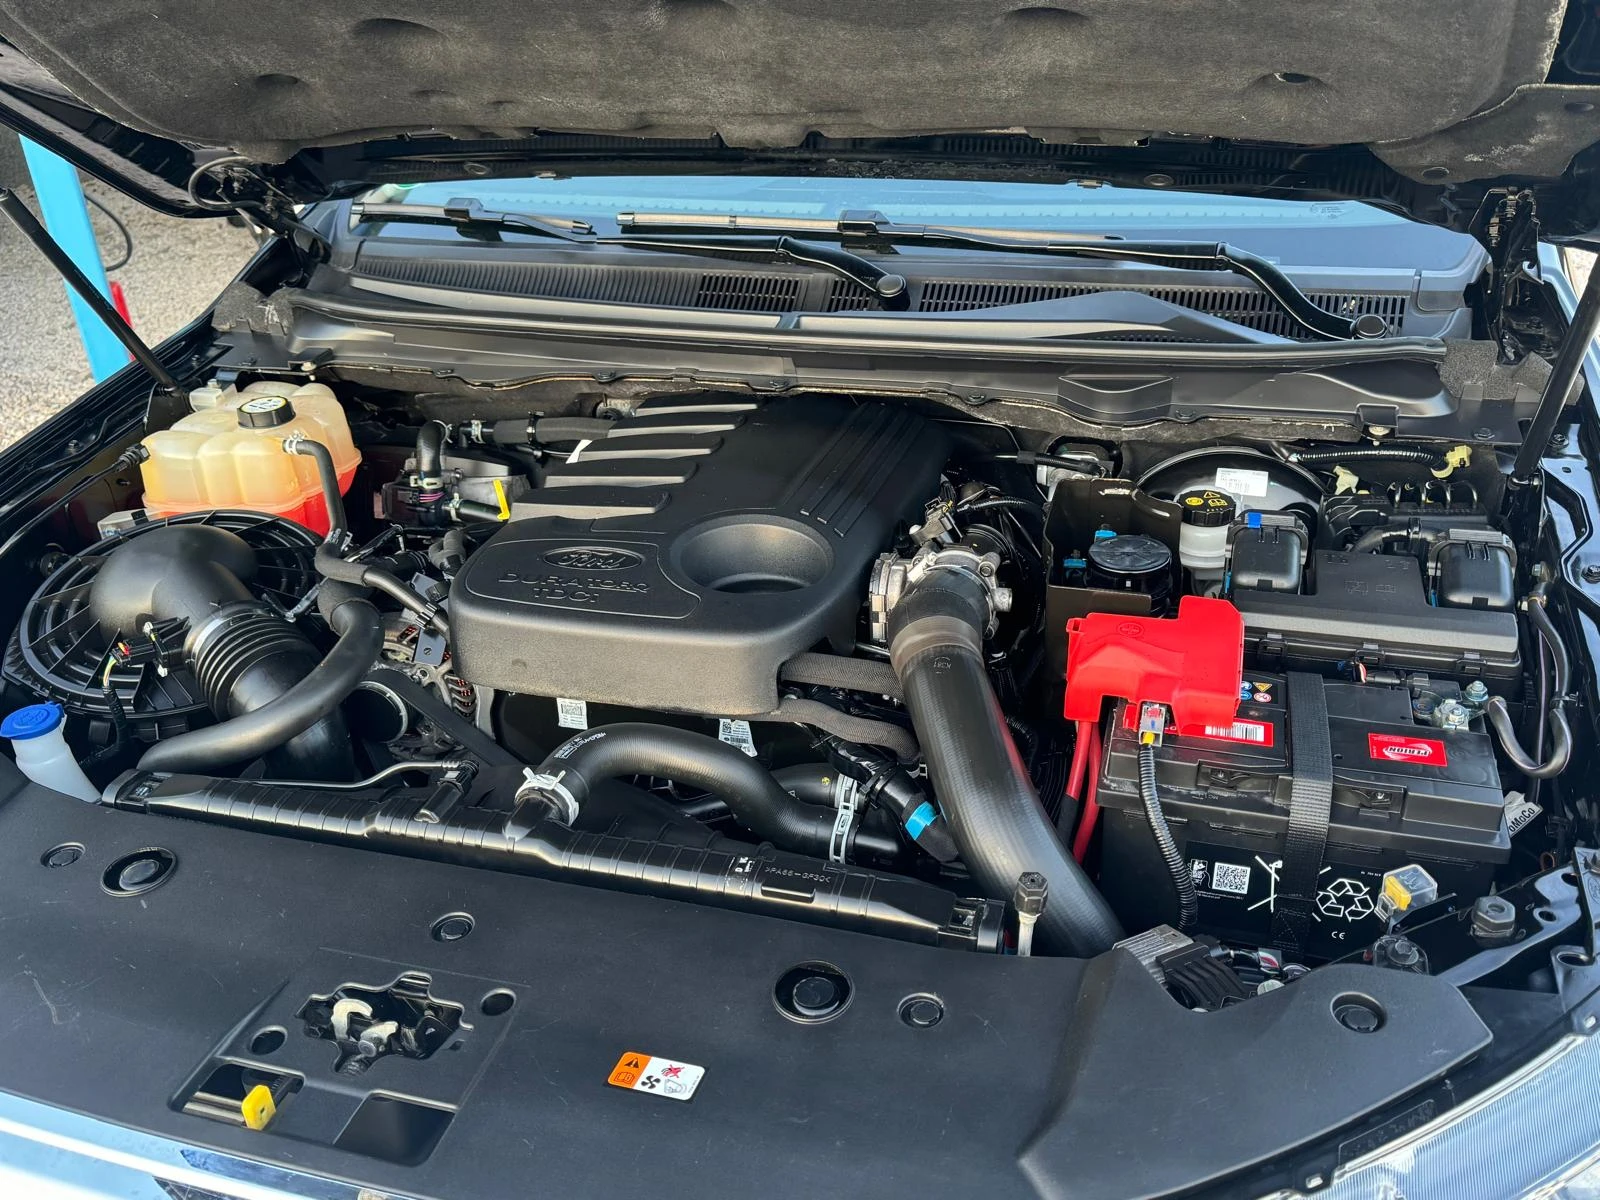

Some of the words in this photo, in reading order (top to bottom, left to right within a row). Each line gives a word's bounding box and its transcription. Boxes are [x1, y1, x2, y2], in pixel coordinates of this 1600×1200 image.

[558, 552, 626, 569] Ford
[498, 573, 649, 593] DURATORQ
[1508, 807, 1536, 832] oMoCo
